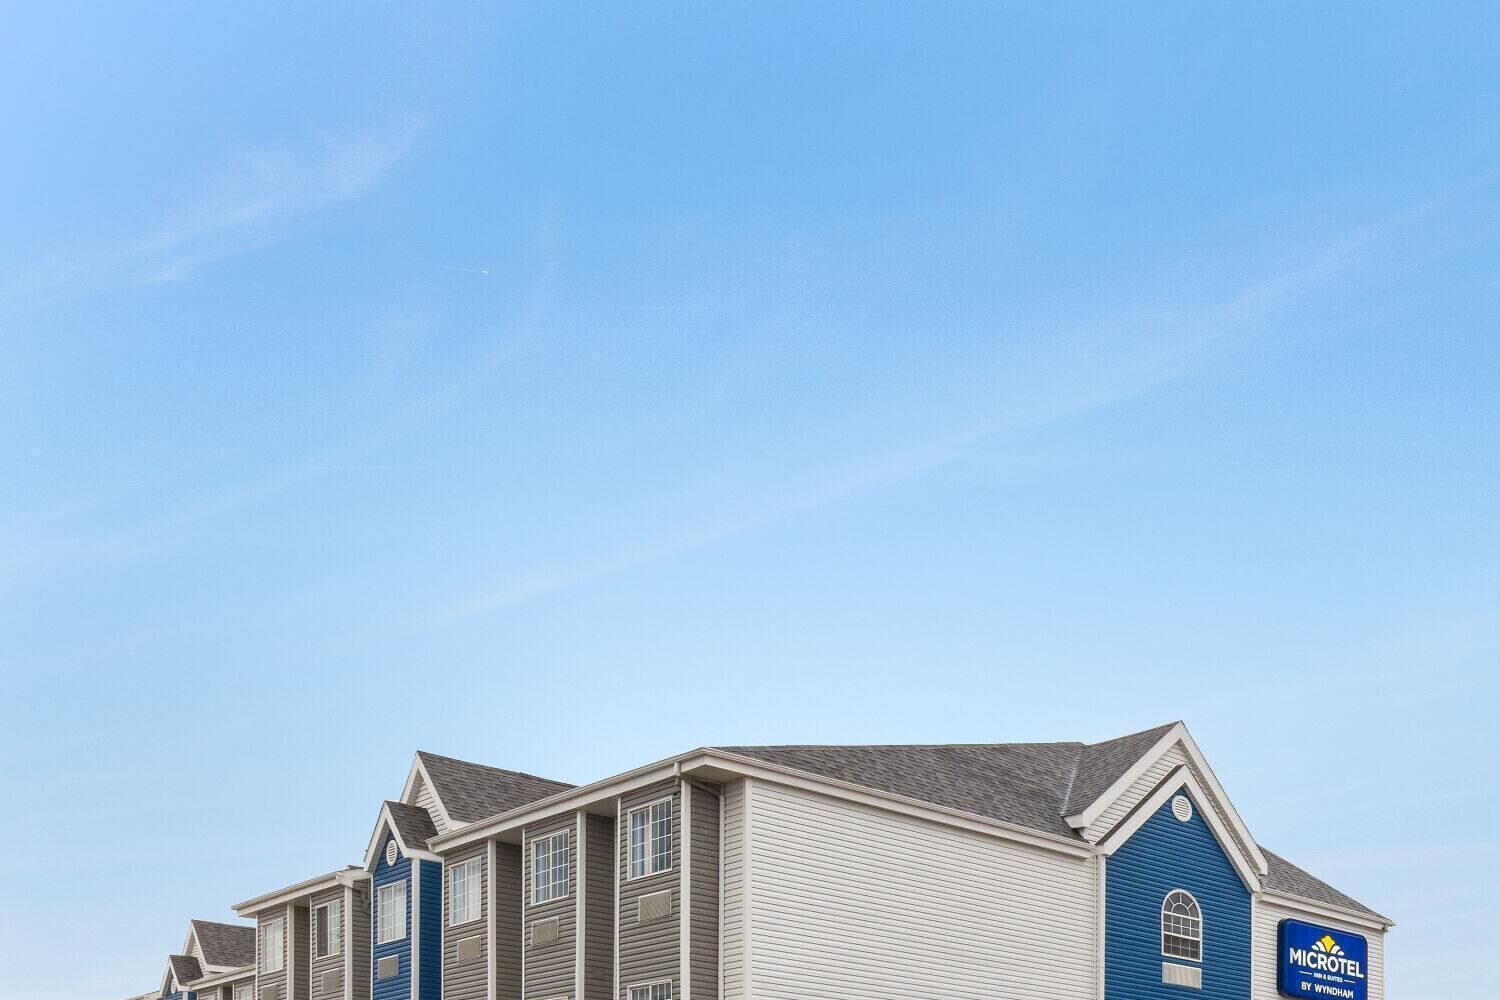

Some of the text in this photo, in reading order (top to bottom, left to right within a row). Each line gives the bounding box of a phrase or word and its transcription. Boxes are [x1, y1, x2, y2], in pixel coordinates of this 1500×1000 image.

[1289, 947, 1364, 978] MICROTEL
[1327, 974, 1343, 983] SUITES
[1301, 981, 1354, 999] BY WYNDHAM
